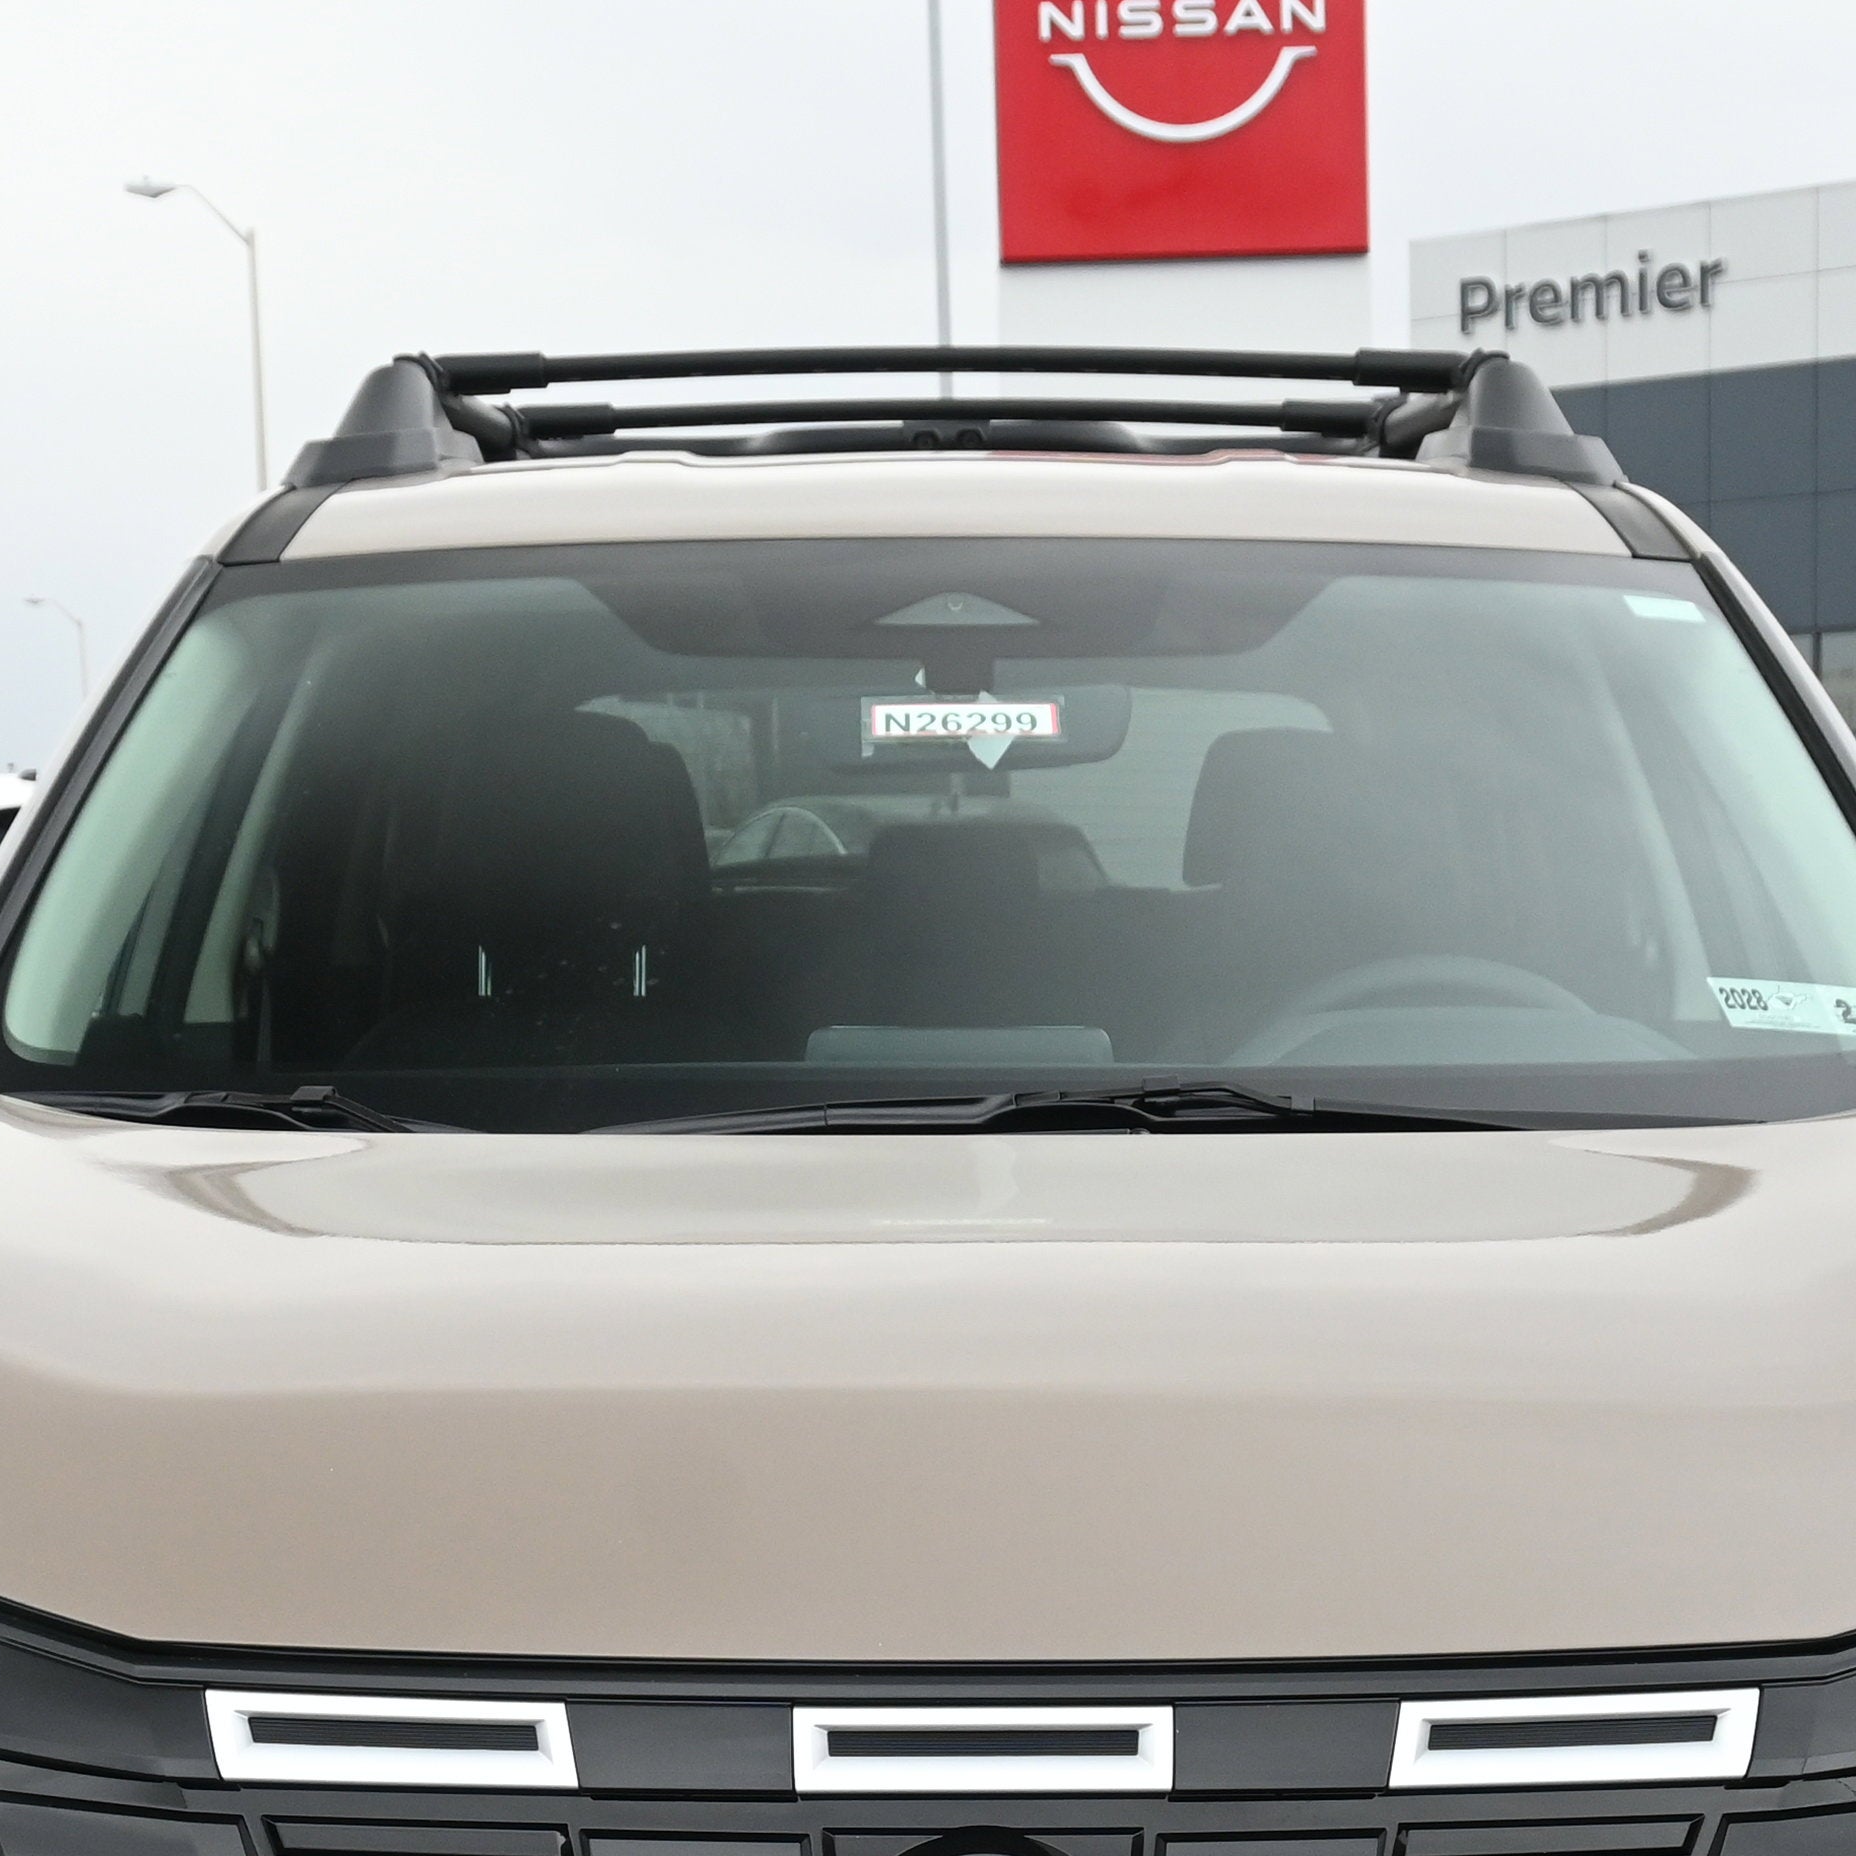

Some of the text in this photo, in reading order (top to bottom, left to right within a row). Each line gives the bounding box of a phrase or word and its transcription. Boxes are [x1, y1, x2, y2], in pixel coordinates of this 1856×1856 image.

[1039, 0, 1327, 41] NISSAN
[1459, 249, 1724, 334] Premier
[884, 712, 1038, 733] N26299
[1718, 987, 1770, 1011] 2028
